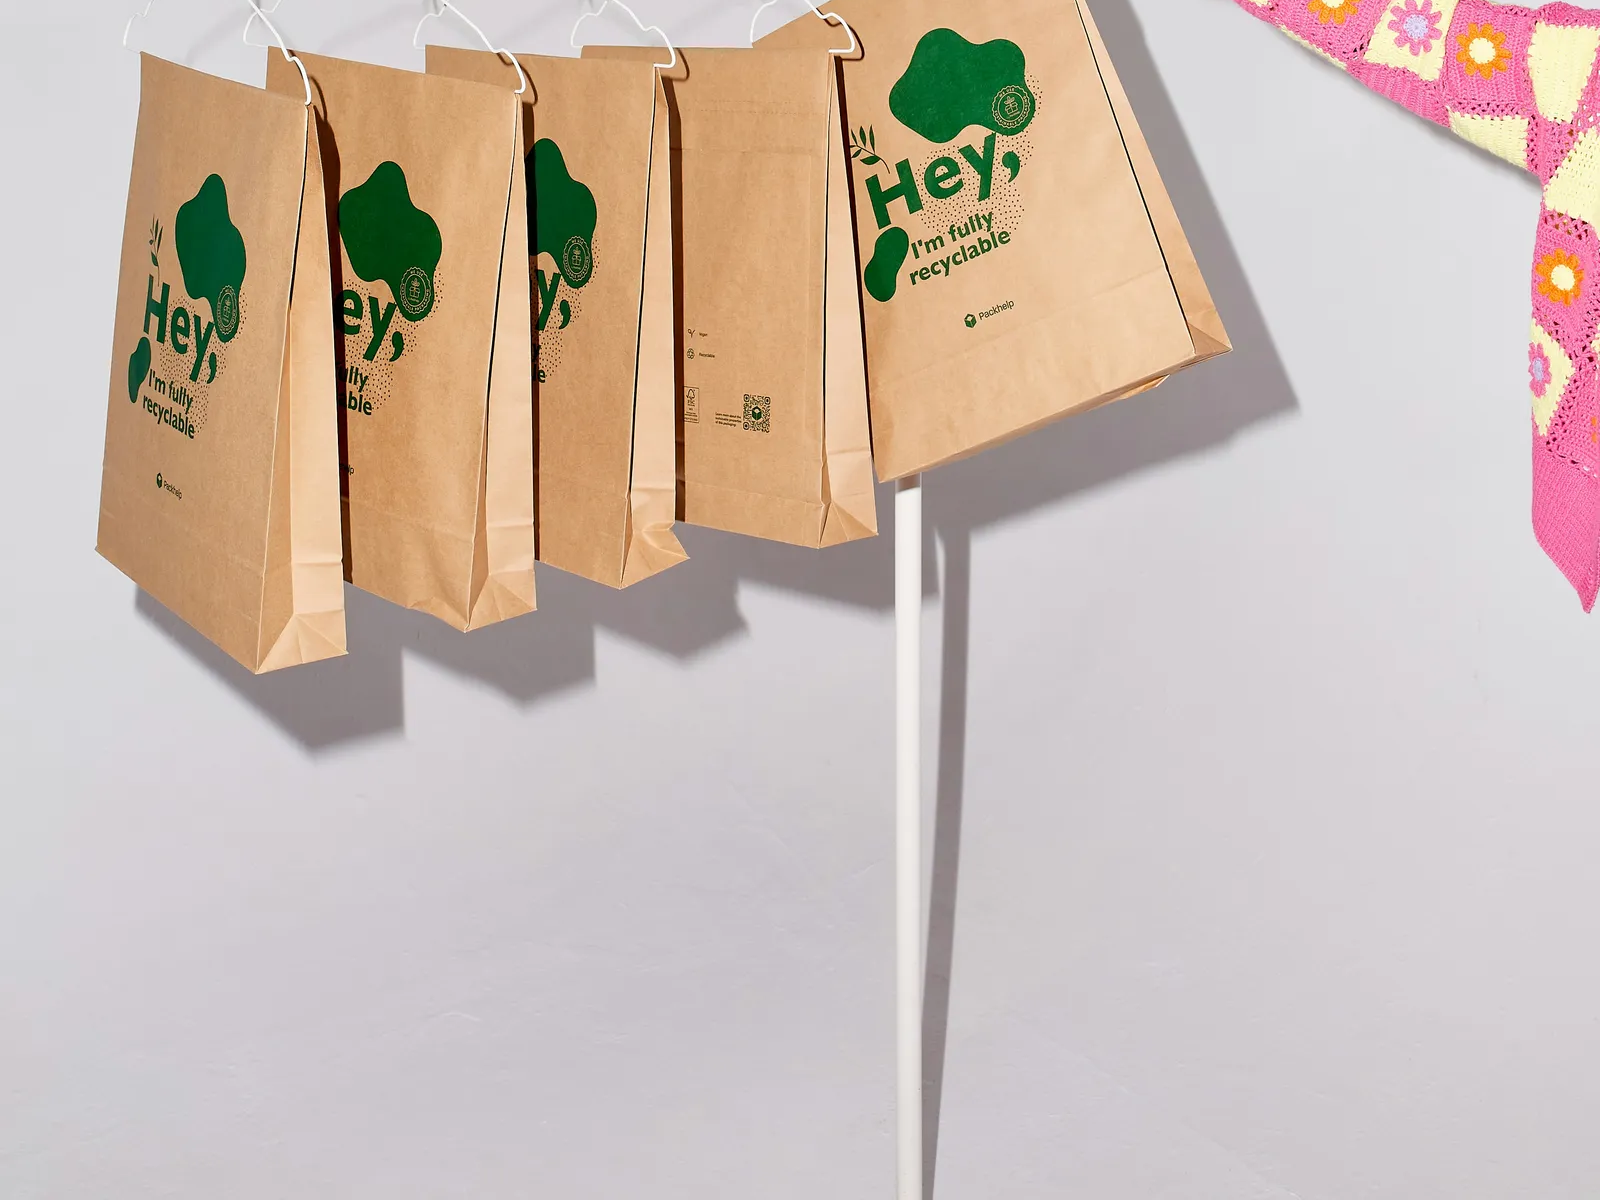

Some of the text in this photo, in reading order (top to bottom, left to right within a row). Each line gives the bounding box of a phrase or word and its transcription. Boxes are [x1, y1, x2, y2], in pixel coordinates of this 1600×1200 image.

[865, 133, 1021, 230] Hey,
[909, 230, 1011, 286] recyclable
[911, 211, 993, 259] I'm fully
[335, 288, 405, 362] ey,
[536, 269, 571, 330] y,
[978, 300, 1015, 320] Packhelp
[143, 274, 218, 384] Hey,
[142, 395, 195, 439] recyclable
[148, 368, 194, 415] I'm fully
[163, 480, 183, 500] Packhelp
